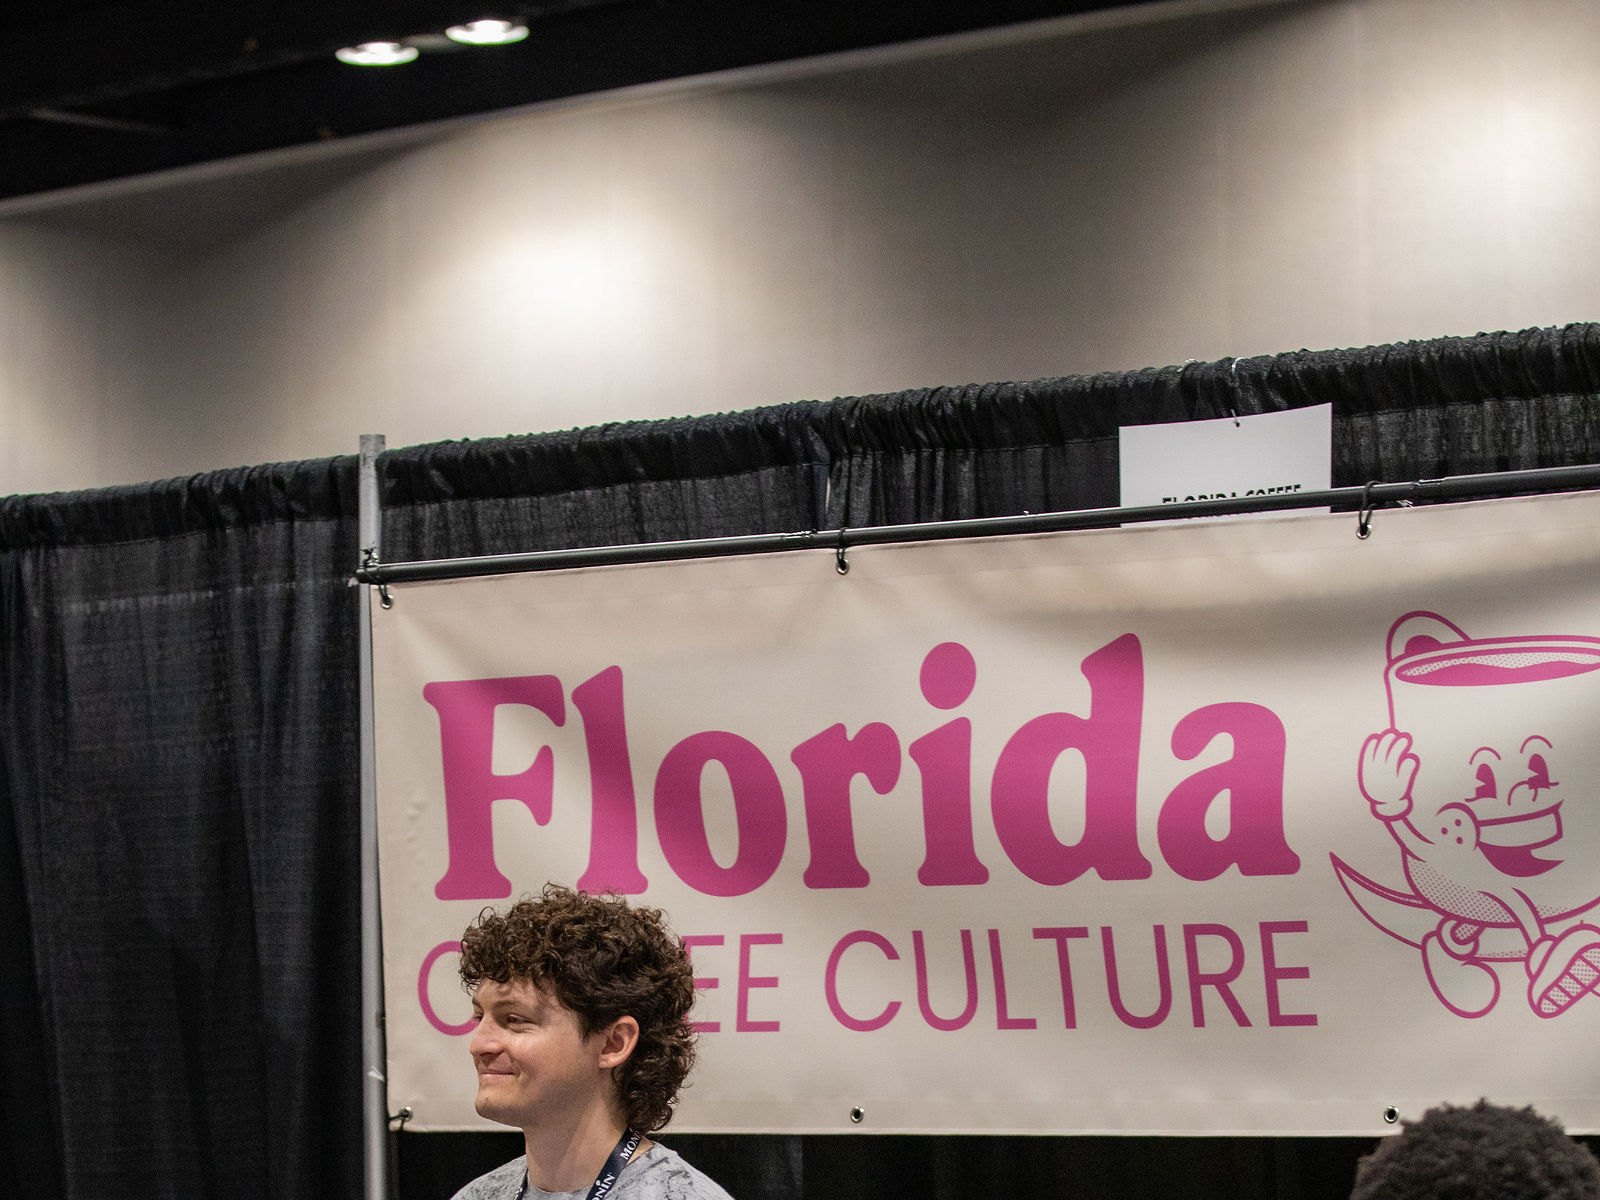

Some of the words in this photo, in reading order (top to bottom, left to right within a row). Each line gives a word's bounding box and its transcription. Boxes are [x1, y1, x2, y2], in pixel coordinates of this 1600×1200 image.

[422, 632, 1300, 901] Florida
[417, 934, 784, 1037] CEE
[824, 921, 1318, 1032] CULTURE
